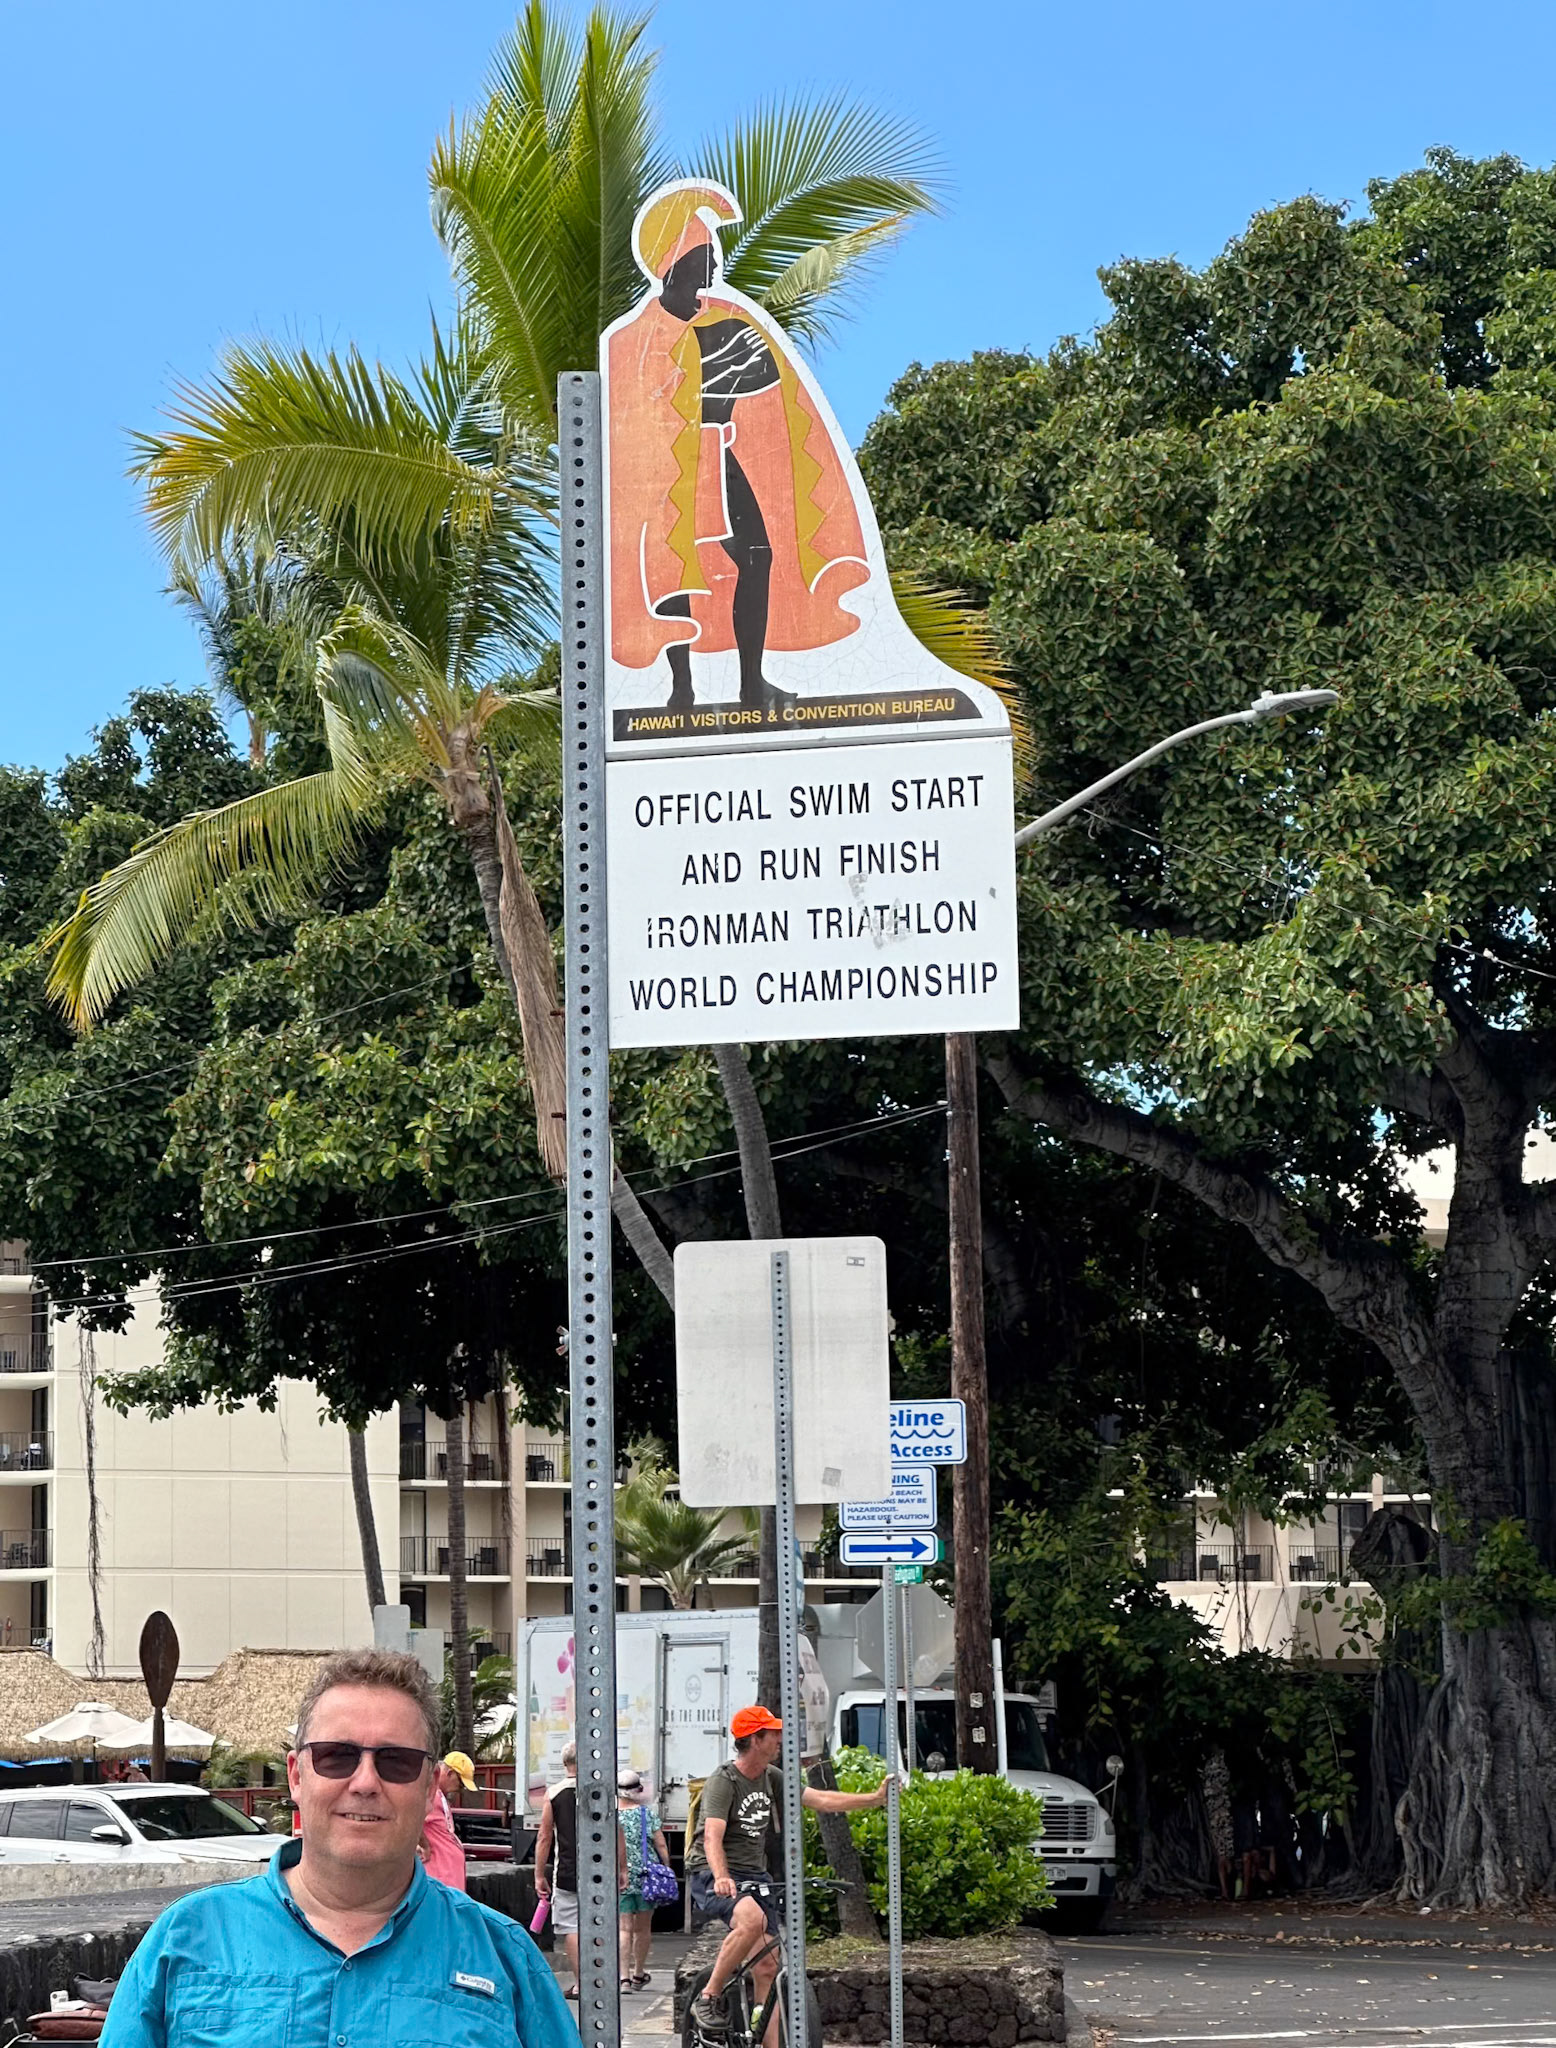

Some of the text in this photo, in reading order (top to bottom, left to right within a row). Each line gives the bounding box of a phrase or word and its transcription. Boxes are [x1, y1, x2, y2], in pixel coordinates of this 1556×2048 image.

[691, 711, 762, 728] VISITORS
[767, 711, 778, 722] &
[783, 702, 886, 721] CONVENTION
[892, 698, 955, 714] BUREAU
[634, 775, 984, 828] OFFICIAL SWIM START
[682, 840, 940, 885] AND RUN FINISH
[648, 900, 977, 948] IRONMAN TRIATHLON
[629, 962, 998, 1011] WORLD CHAMPIONSHIP
[891, 1443, 952, 1457] Access
